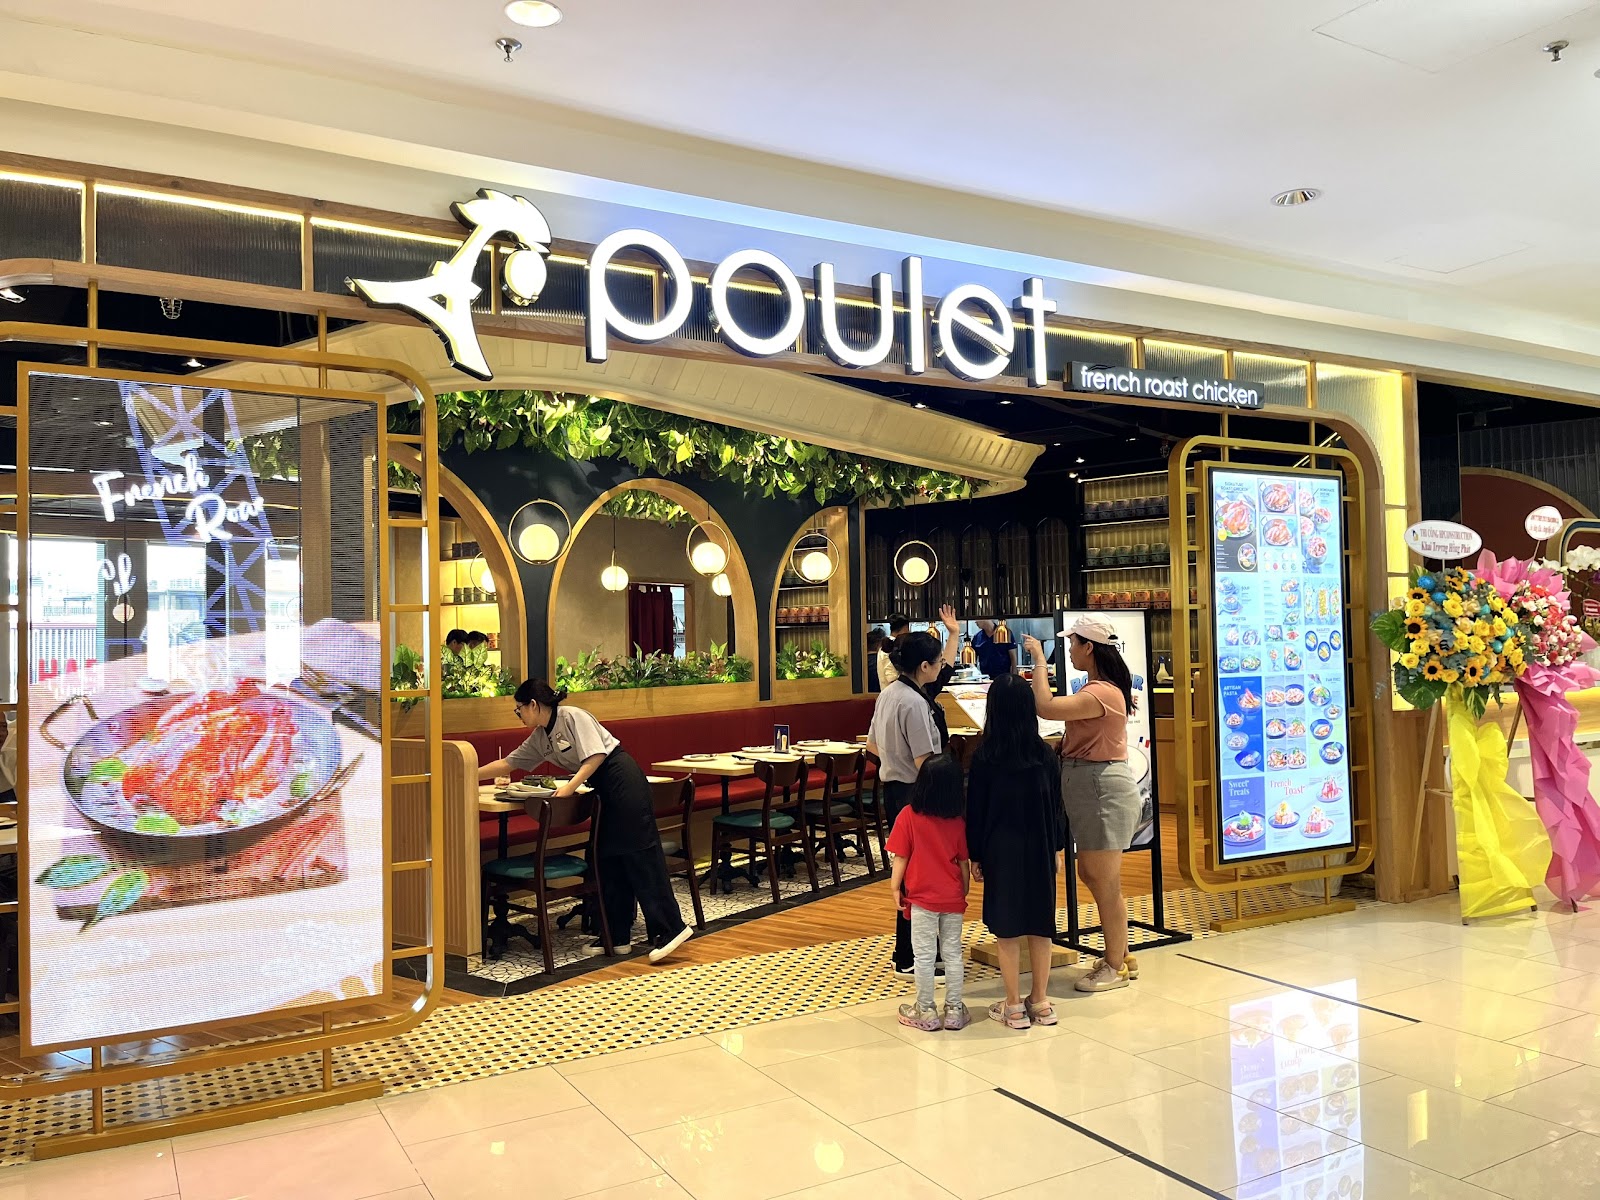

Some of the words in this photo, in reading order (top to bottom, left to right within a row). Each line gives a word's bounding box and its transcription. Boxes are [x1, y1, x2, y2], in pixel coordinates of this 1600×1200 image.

[586, 228, 1057, 387] poulet
[1081, 365, 1140, 393] french
[1145, 377, 1188, 396] roast
[1192, 380, 1258, 405] chicken
[91, 453, 210, 522] French
[1228, 779, 1250, 789] Sweet
[1270, 778, 1292, 788] French
[1229, 788, 1250, 797] Treats
[1283, 785, 1305, 796] Toast
